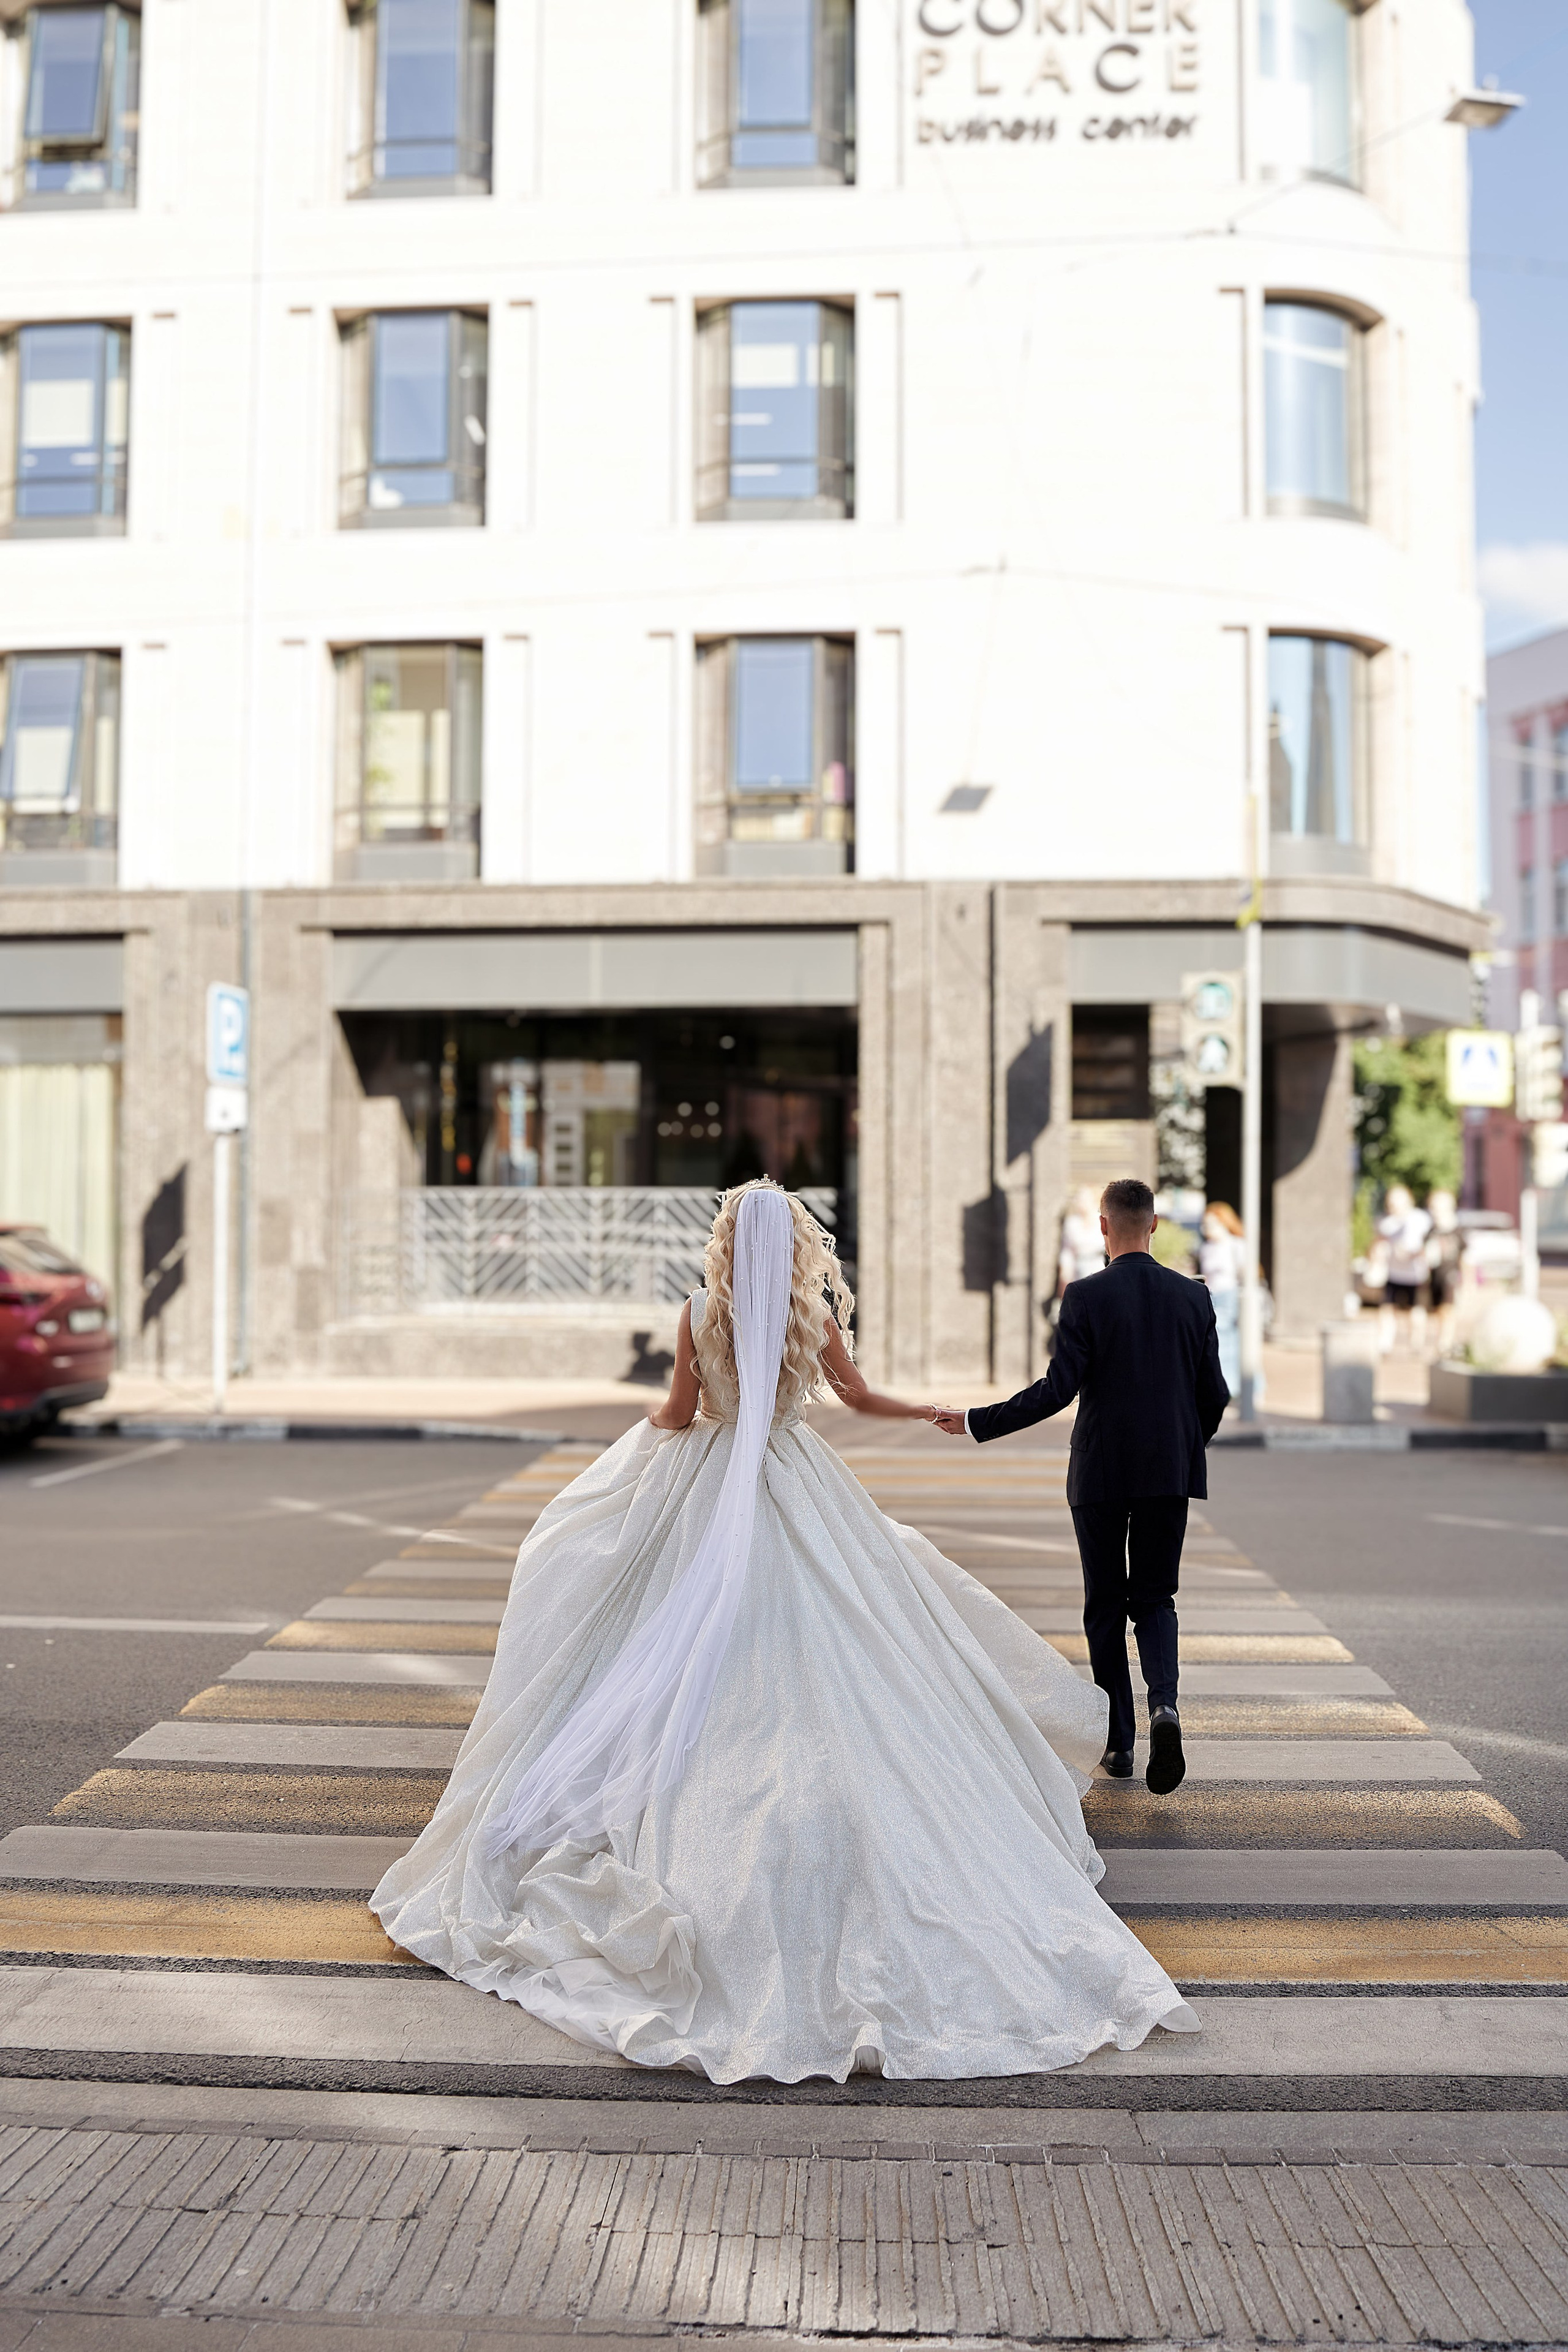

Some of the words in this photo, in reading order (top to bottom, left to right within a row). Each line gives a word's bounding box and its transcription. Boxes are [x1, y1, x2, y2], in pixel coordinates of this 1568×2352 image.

[918, 0, 1196, 37] CORNER
[916, 43, 1199, 96] PLACE
[917, 113, 1056, 144] business
[1082, 113, 1197, 141] center
